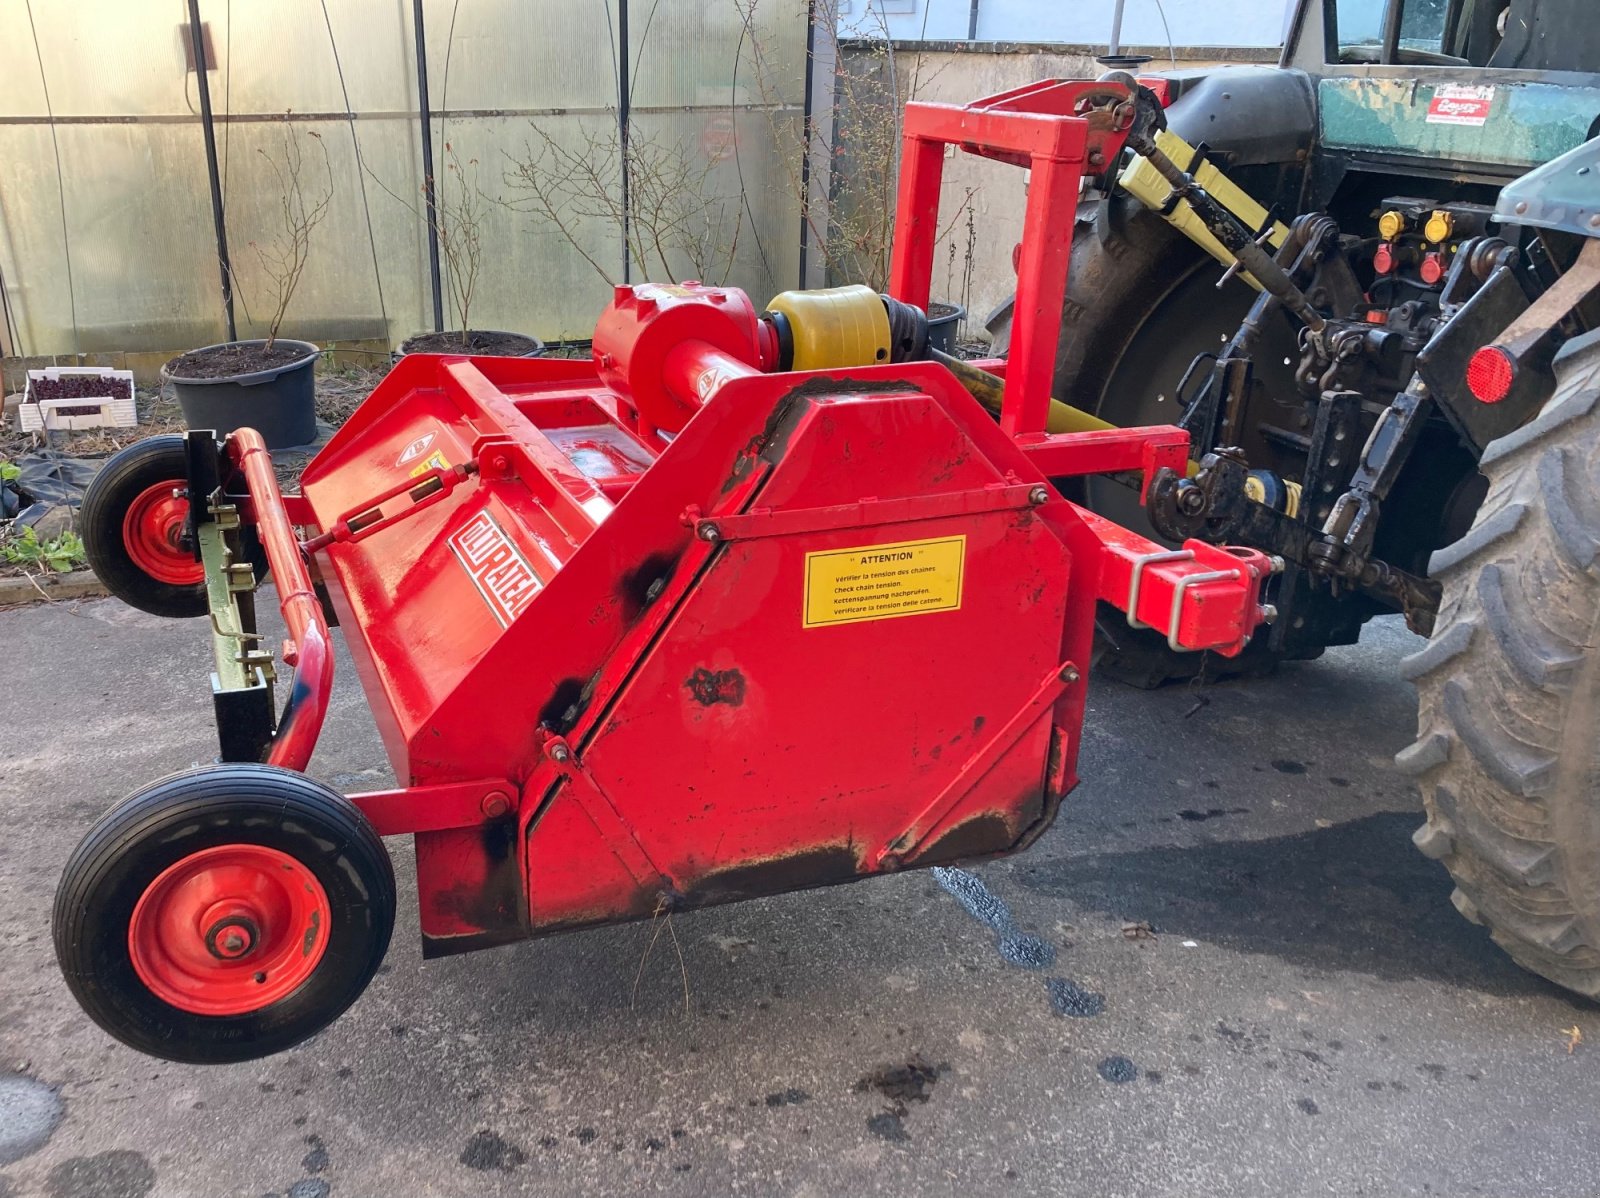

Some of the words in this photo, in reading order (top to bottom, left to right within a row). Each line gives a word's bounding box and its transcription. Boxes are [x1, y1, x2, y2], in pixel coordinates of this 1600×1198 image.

[860, 551, 913, 565] ATTENTION
[870, 570, 896, 579] tension
[834, 586, 854, 594] Check
[855, 584, 875, 592] chain
[833, 593, 890, 604] Kettenspannung
[902, 599, 919, 607] delle
